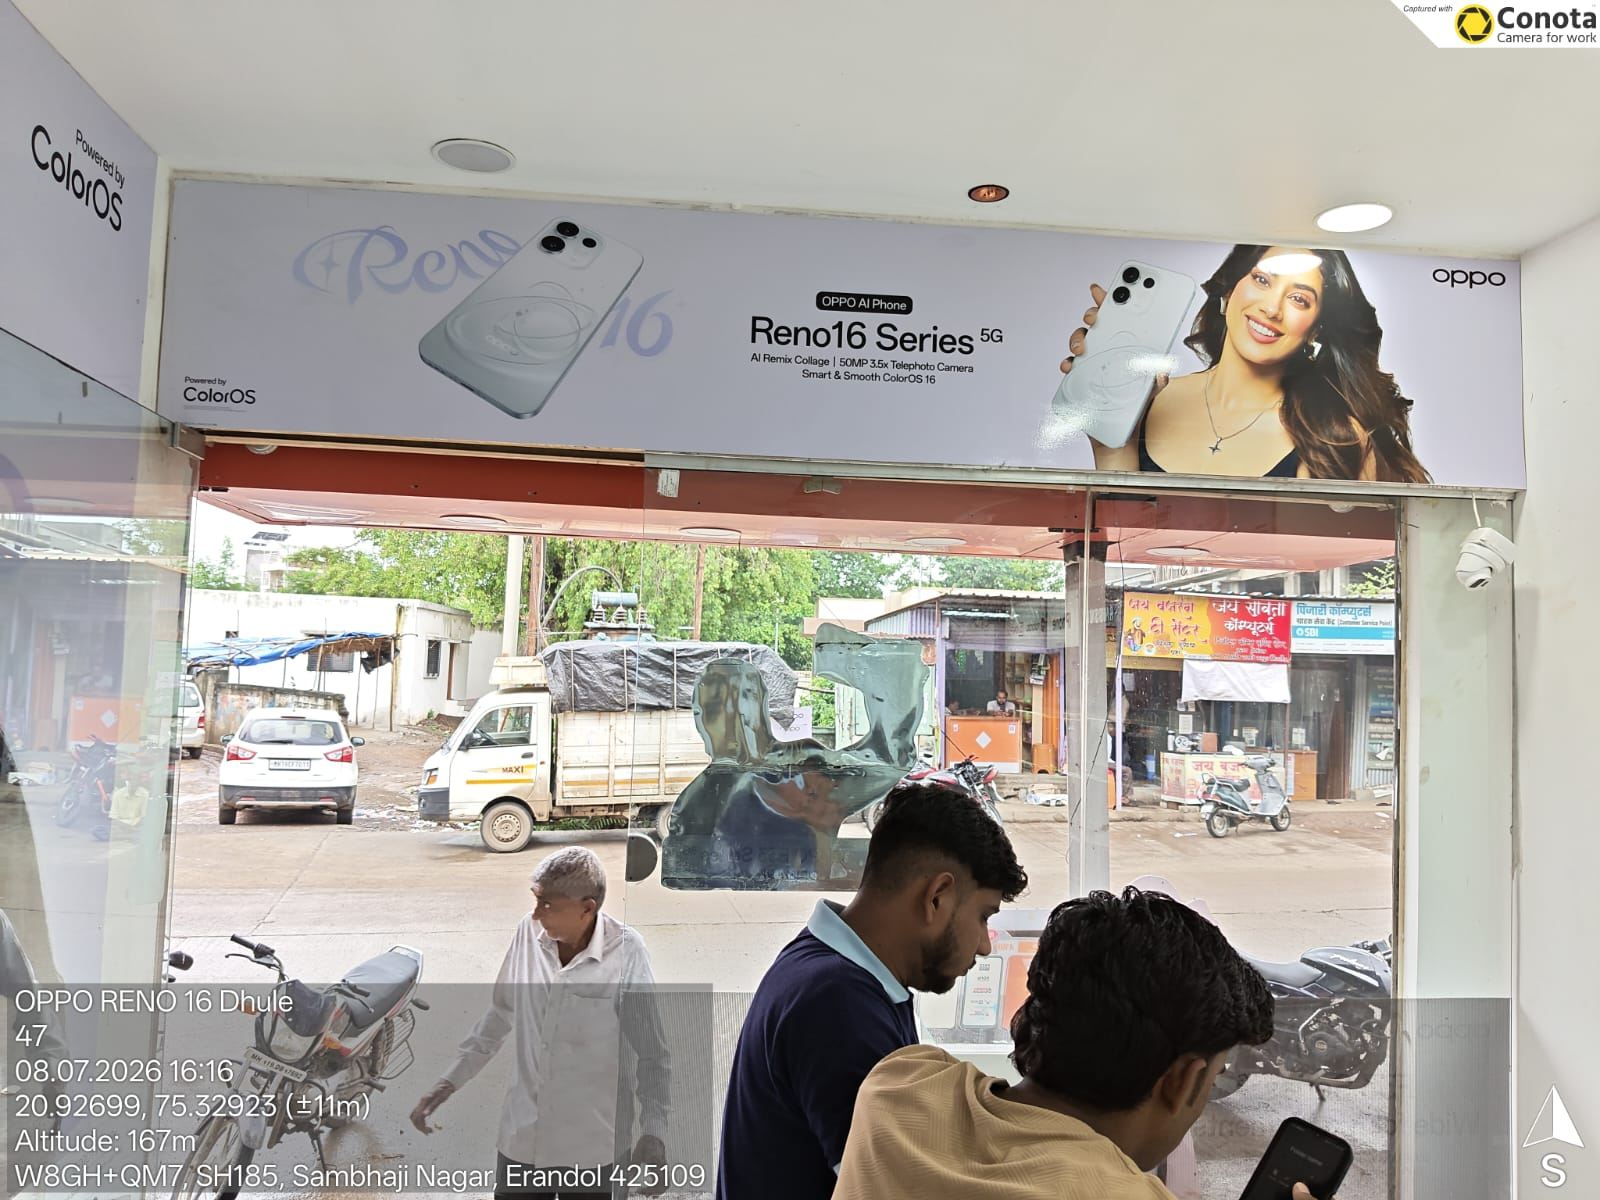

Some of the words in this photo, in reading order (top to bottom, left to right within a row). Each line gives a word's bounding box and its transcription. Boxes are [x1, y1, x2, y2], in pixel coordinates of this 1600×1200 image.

[76, 128, 114, 177] Powered
[115, 164, 125, 190] by
[31, 125, 122, 231] ColorOS
[1432, 268, 1506, 288] oppo
[822, 296, 856, 308] OPPO
[858, 297, 870, 308] AI
[872, 299, 907, 310] Phone
[600, 290, 675, 357] 16
[751, 315, 867, 350] Reno16
[876, 323, 975, 355] Series
[980, 328, 1003, 343] 5G
[751, 353, 761, 363] AI
[763, 354, 792, 365] Remix
[795, 355, 830, 367] Collage
[839, 357, 868, 368] 50MP
[869, 358, 888, 369] 3.5x
[891, 359, 935, 372] Telephoto
[937, 362, 974, 373] Camera
[184, 376, 217, 385] Powered
[218, 377, 227, 386] by
[802, 369, 832, 379] Smart
[834, 370, 842, 380] &
[843, 370, 880, 382] Smooth
[882, 372, 923, 384] ColorOS
[925, 374, 936, 384] 16
[183, 387, 256, 405] ColorOS
[1305, 628, 1319, 637] SBI
